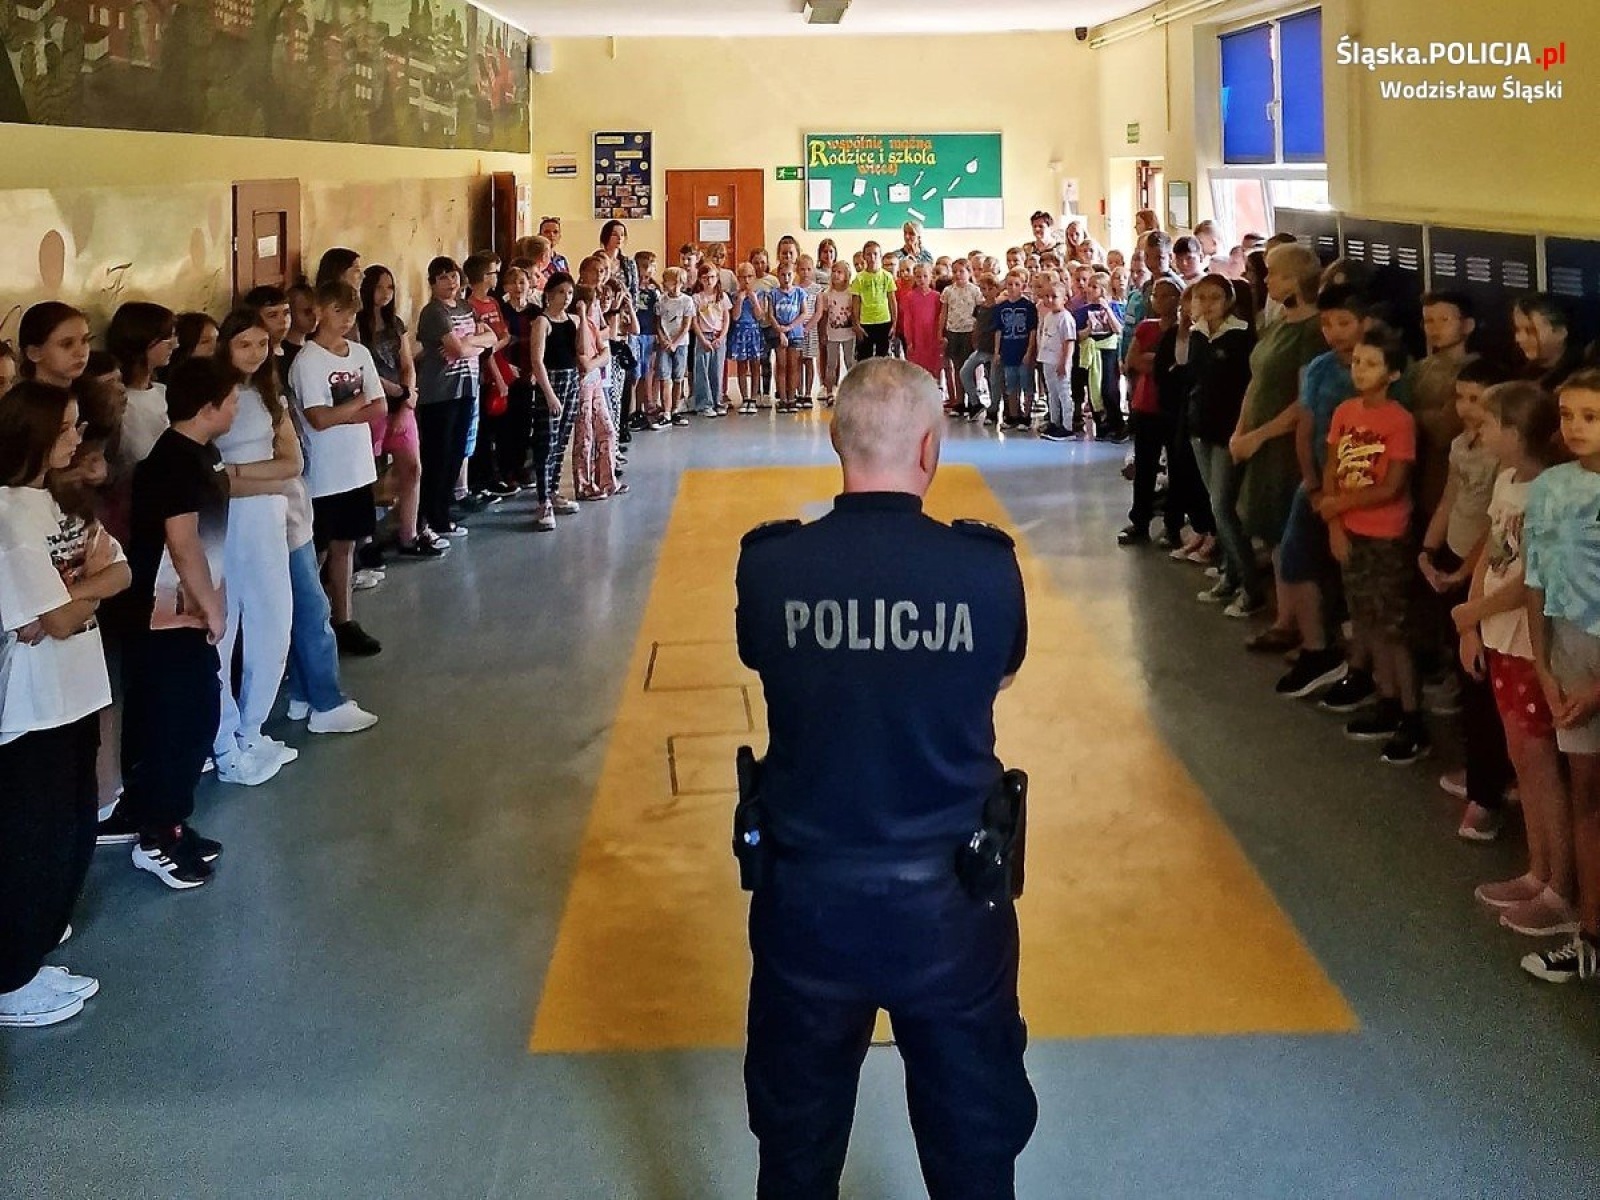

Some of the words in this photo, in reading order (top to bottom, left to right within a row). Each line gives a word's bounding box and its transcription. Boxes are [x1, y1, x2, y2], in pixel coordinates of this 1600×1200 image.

[808, 140, 875, 168] Rodzice
[879, 149, 885, 164] i
[785, 599, 974, 653] POLICJA
